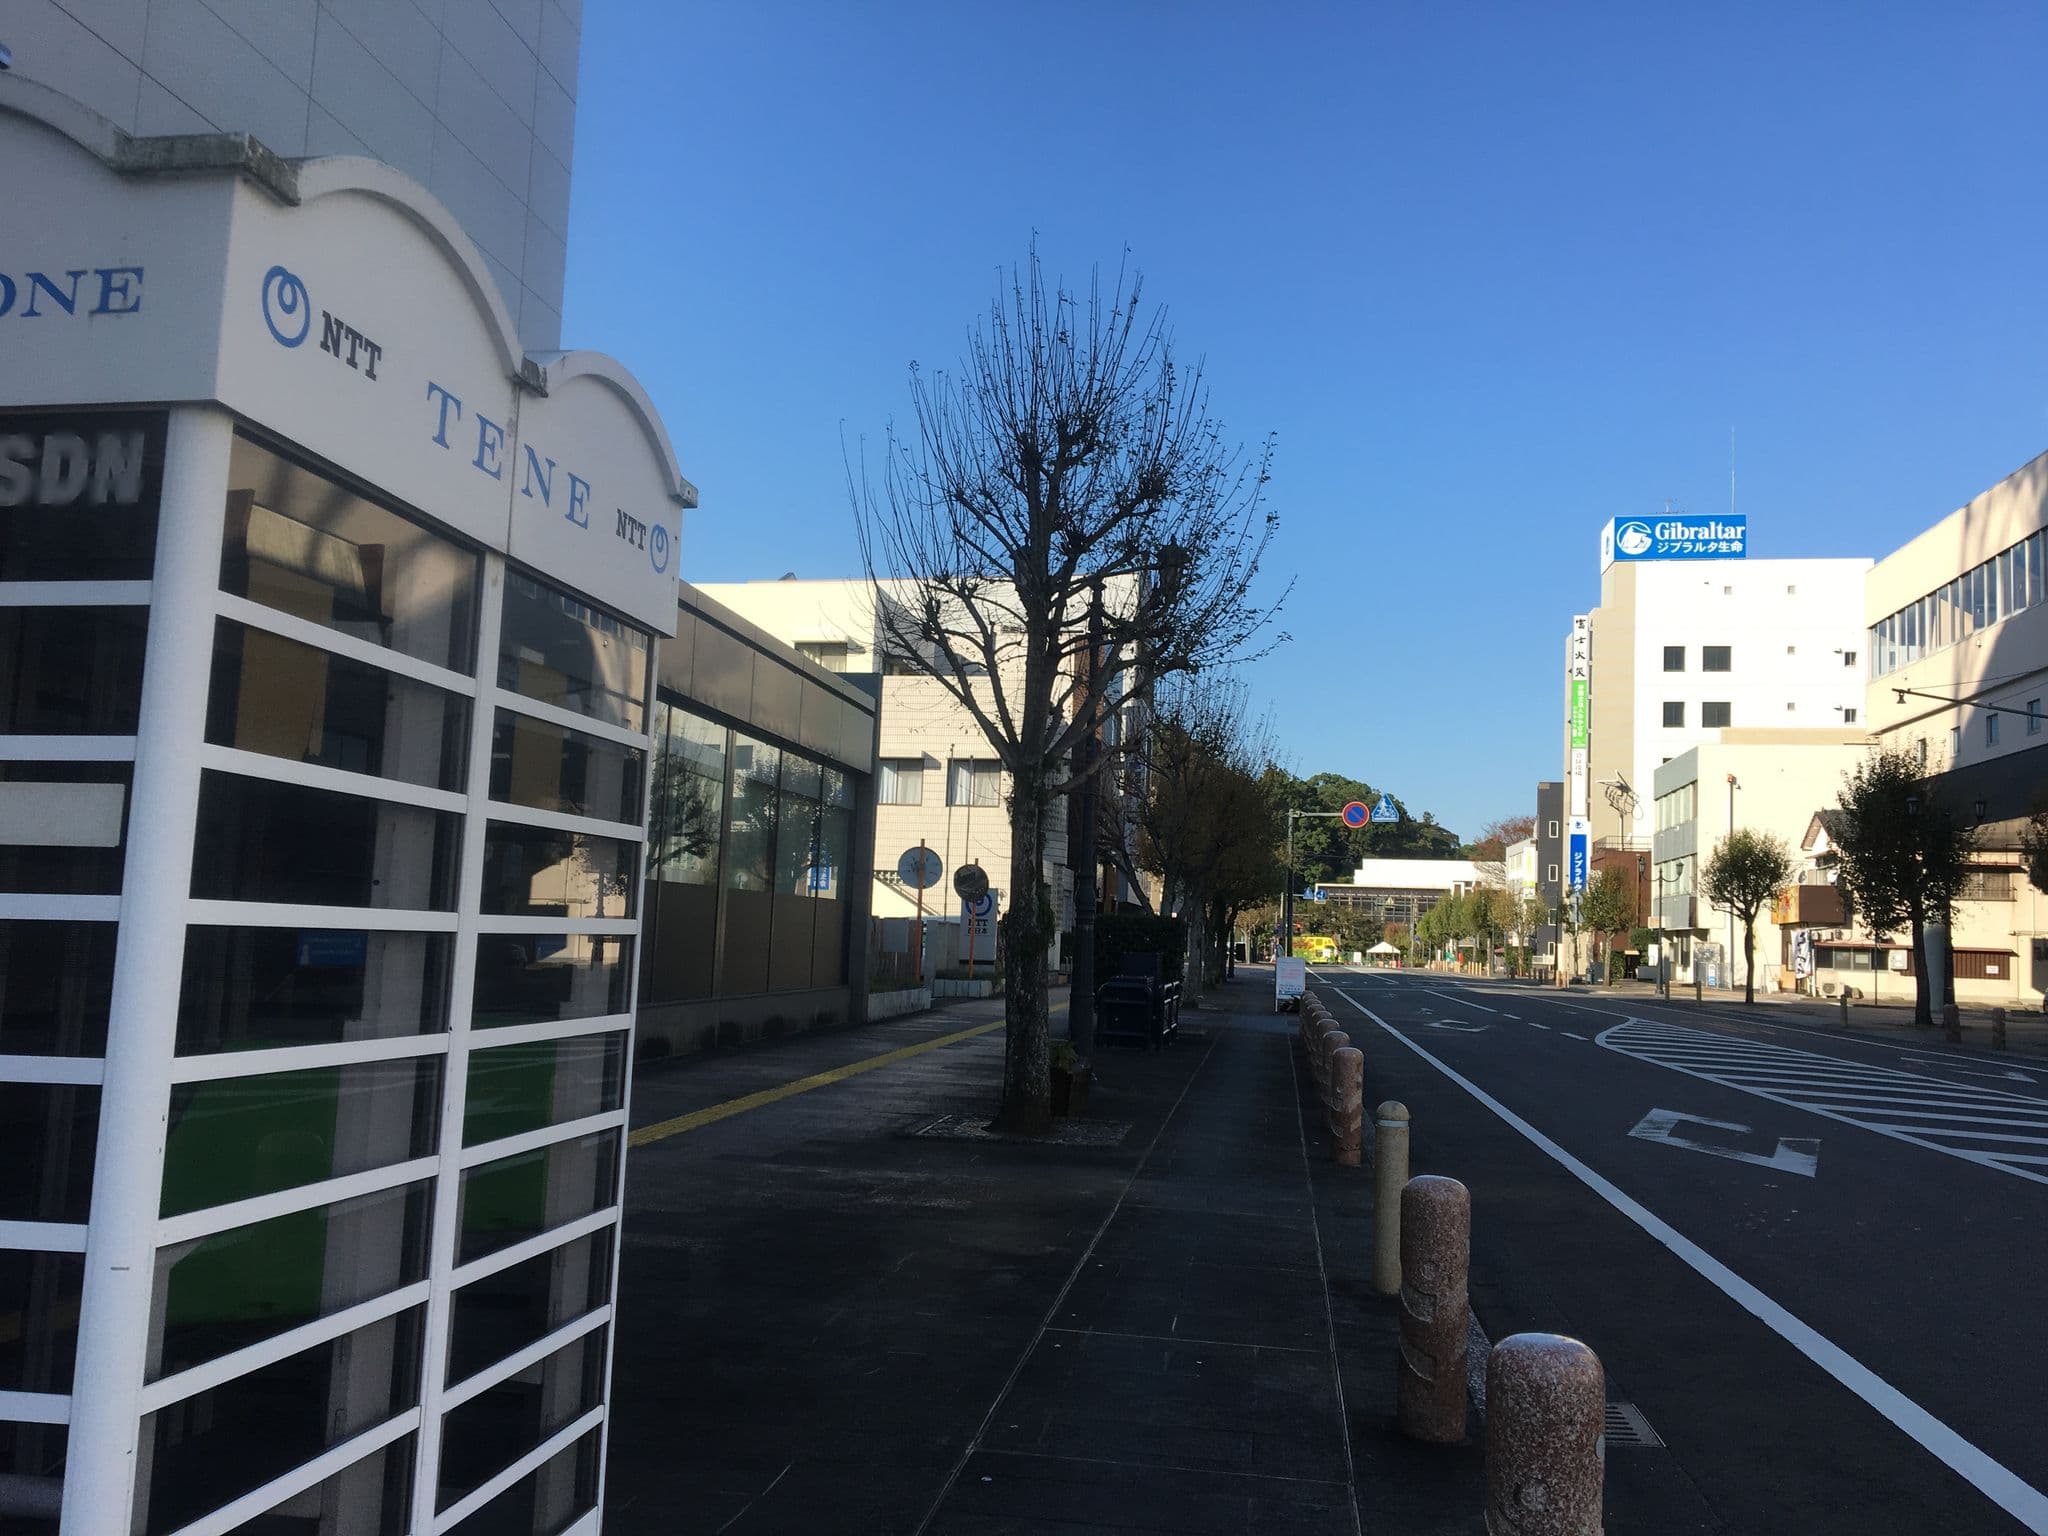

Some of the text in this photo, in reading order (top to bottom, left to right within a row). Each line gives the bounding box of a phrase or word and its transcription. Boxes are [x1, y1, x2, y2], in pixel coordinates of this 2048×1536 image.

[320, 311, 382, 381] NTT
[616, 508, 648, 551] NTT
[1655, 521, 1745, 540] Gibraltar
[1657, 541, 1743, 553] ジブラルタ生命
[1575, 618, 1587, 677] 富士火災
